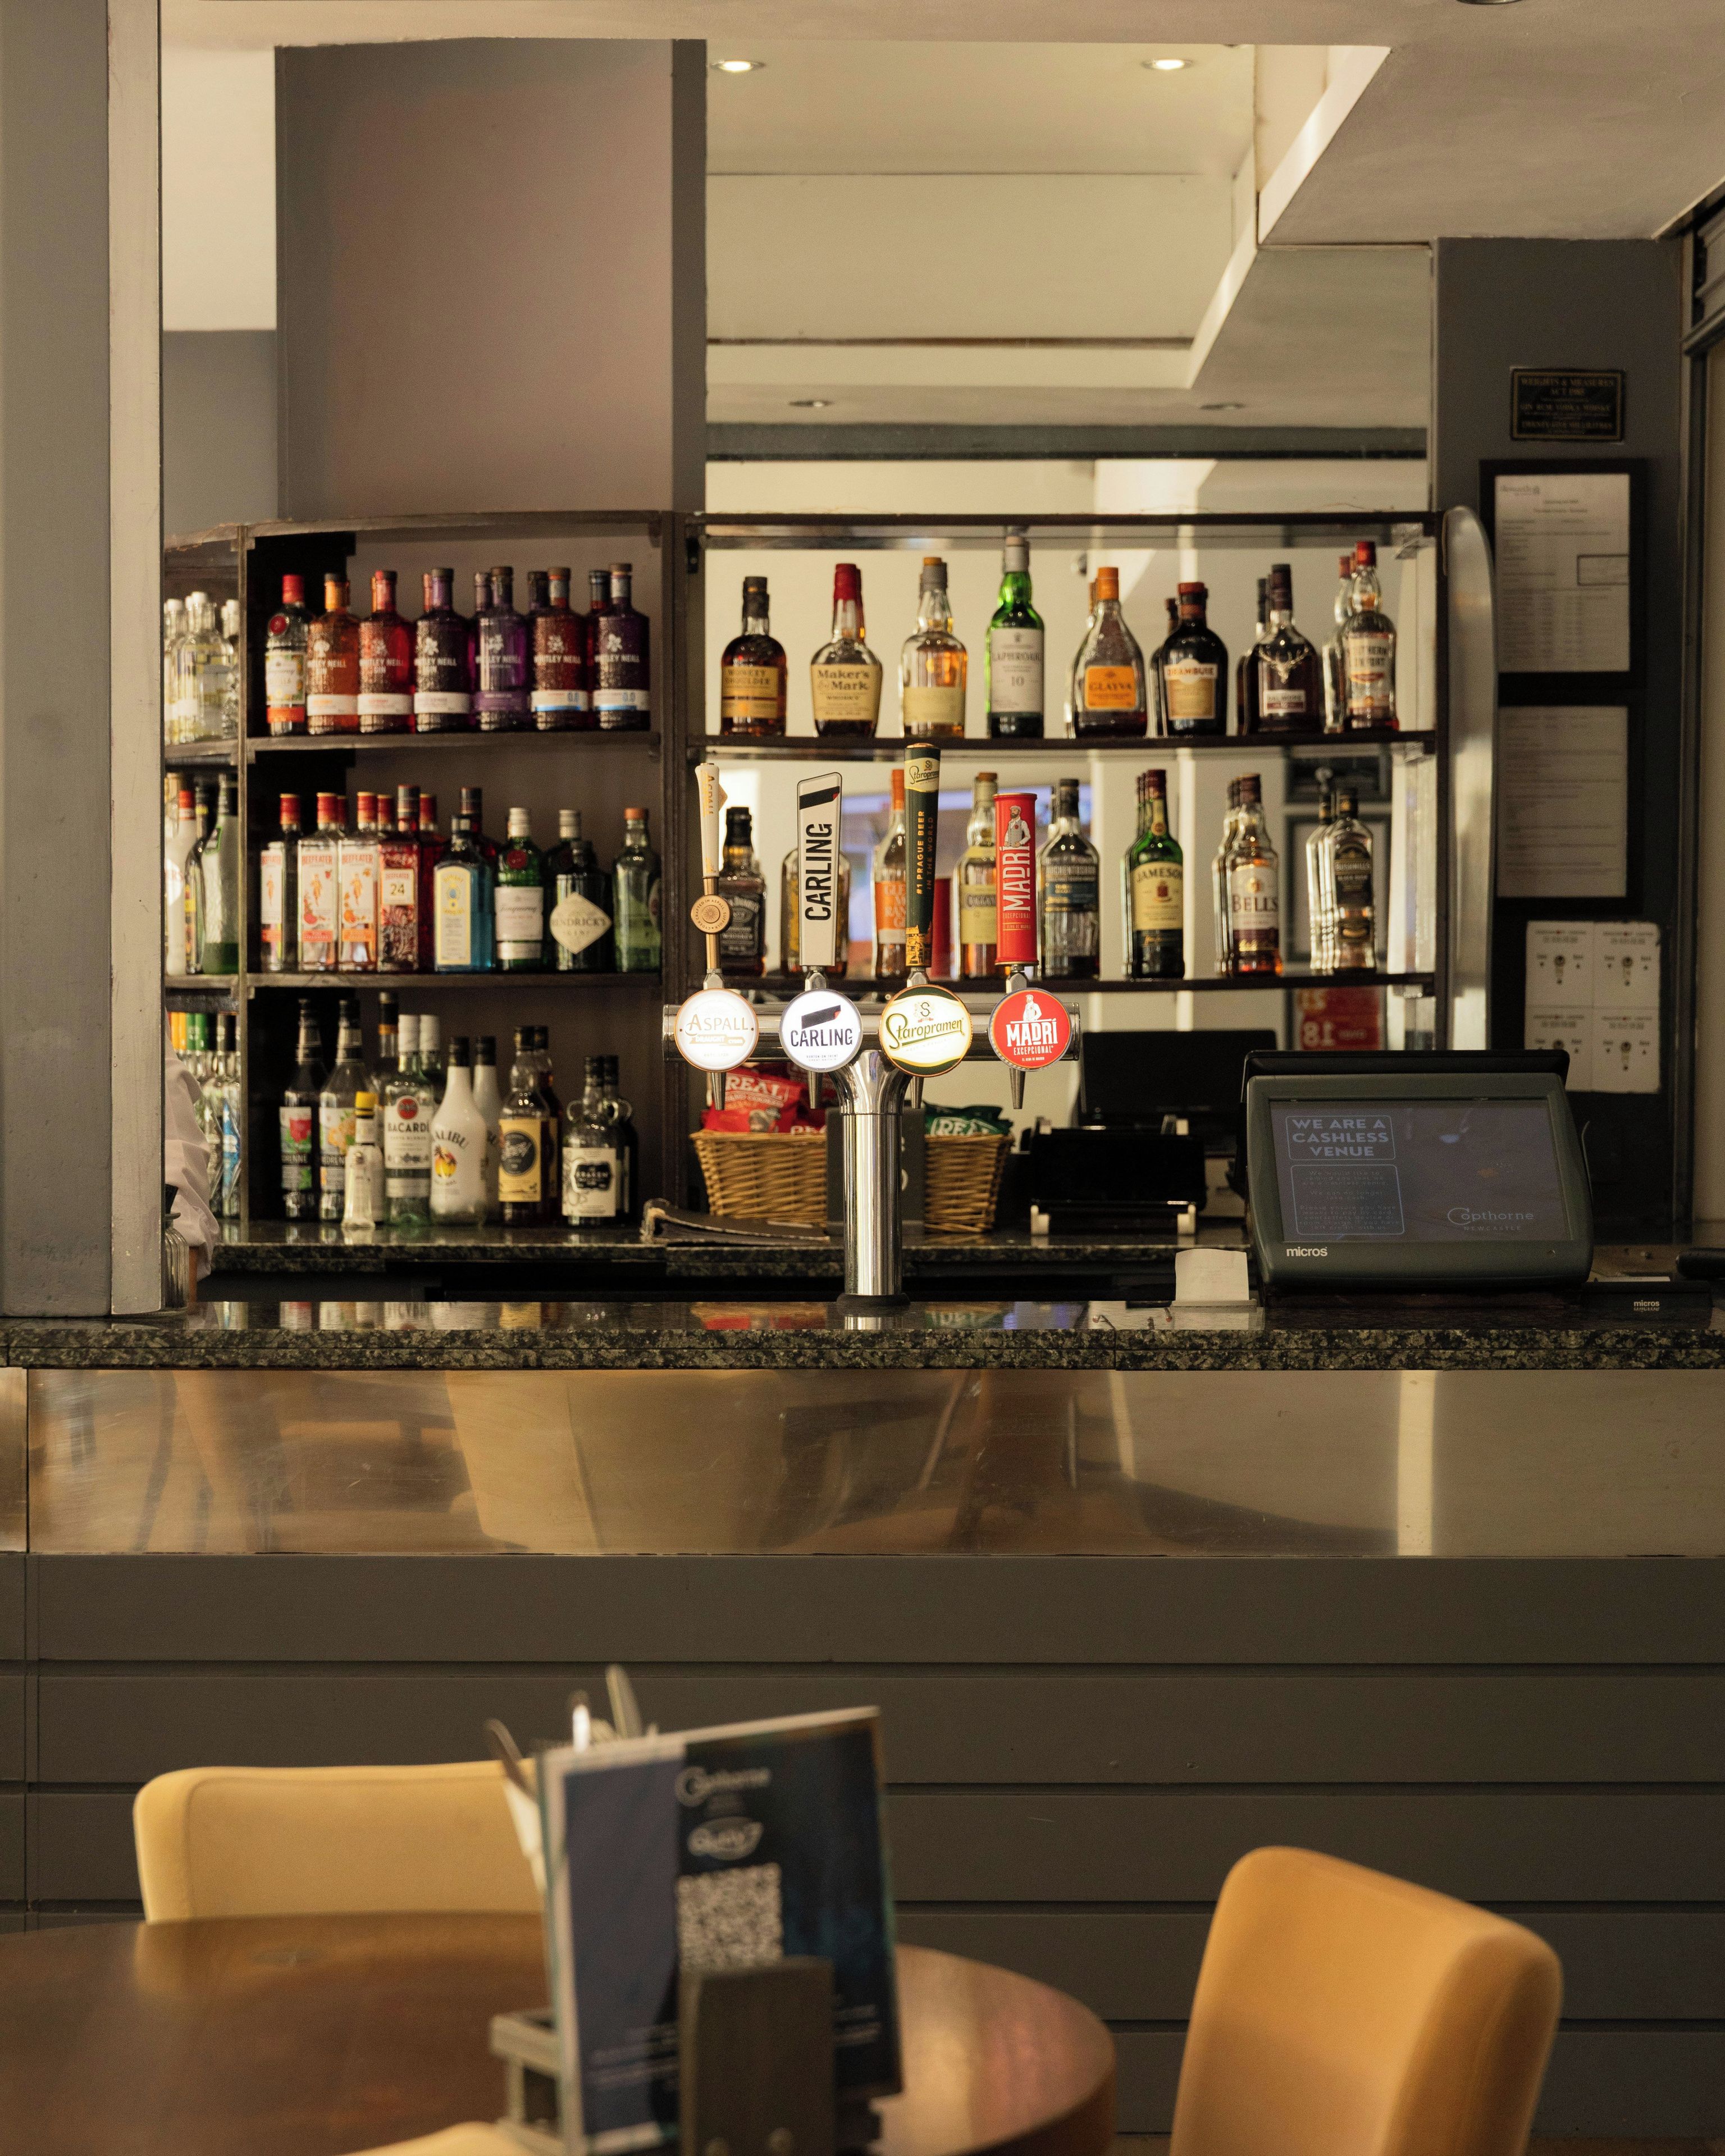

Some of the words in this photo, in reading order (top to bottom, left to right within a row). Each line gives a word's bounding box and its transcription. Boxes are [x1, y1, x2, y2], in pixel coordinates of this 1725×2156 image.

[818, 669, 870, 679] Maker's
[831, 680, 869, 690] Mark
[805, 824, 832, 921] CARLING
[391, 883, 405, 896] 24
[916, 884, 923, 894] #1
[927, 881, 932, 890] IN
[689, 1014, 749, 1031] ASPALL
[886, 1013, 965, 1049] Staropramen
[1006, 1018, 1058, 1047] MADRÍ
[790, 1028, 853, 1047] CARLING
[1013, 1045, 1053, 1056] EXCEPCIONAL
[725, 1076, 783, 1099] REAL
[1292, 1119, 1323, 1129] WE
[1329, 1119, 1366, 1129] ARE
[1373, 1119, 1386, 1129] A
[1292, 1132, 1389, 1143] CASHLESS
[1310, 1146, 1375, 1157] VENUE
[1447, 1207, 1534, 1226] Copthorne
[1286, 1246, 1327, 1257] micros
